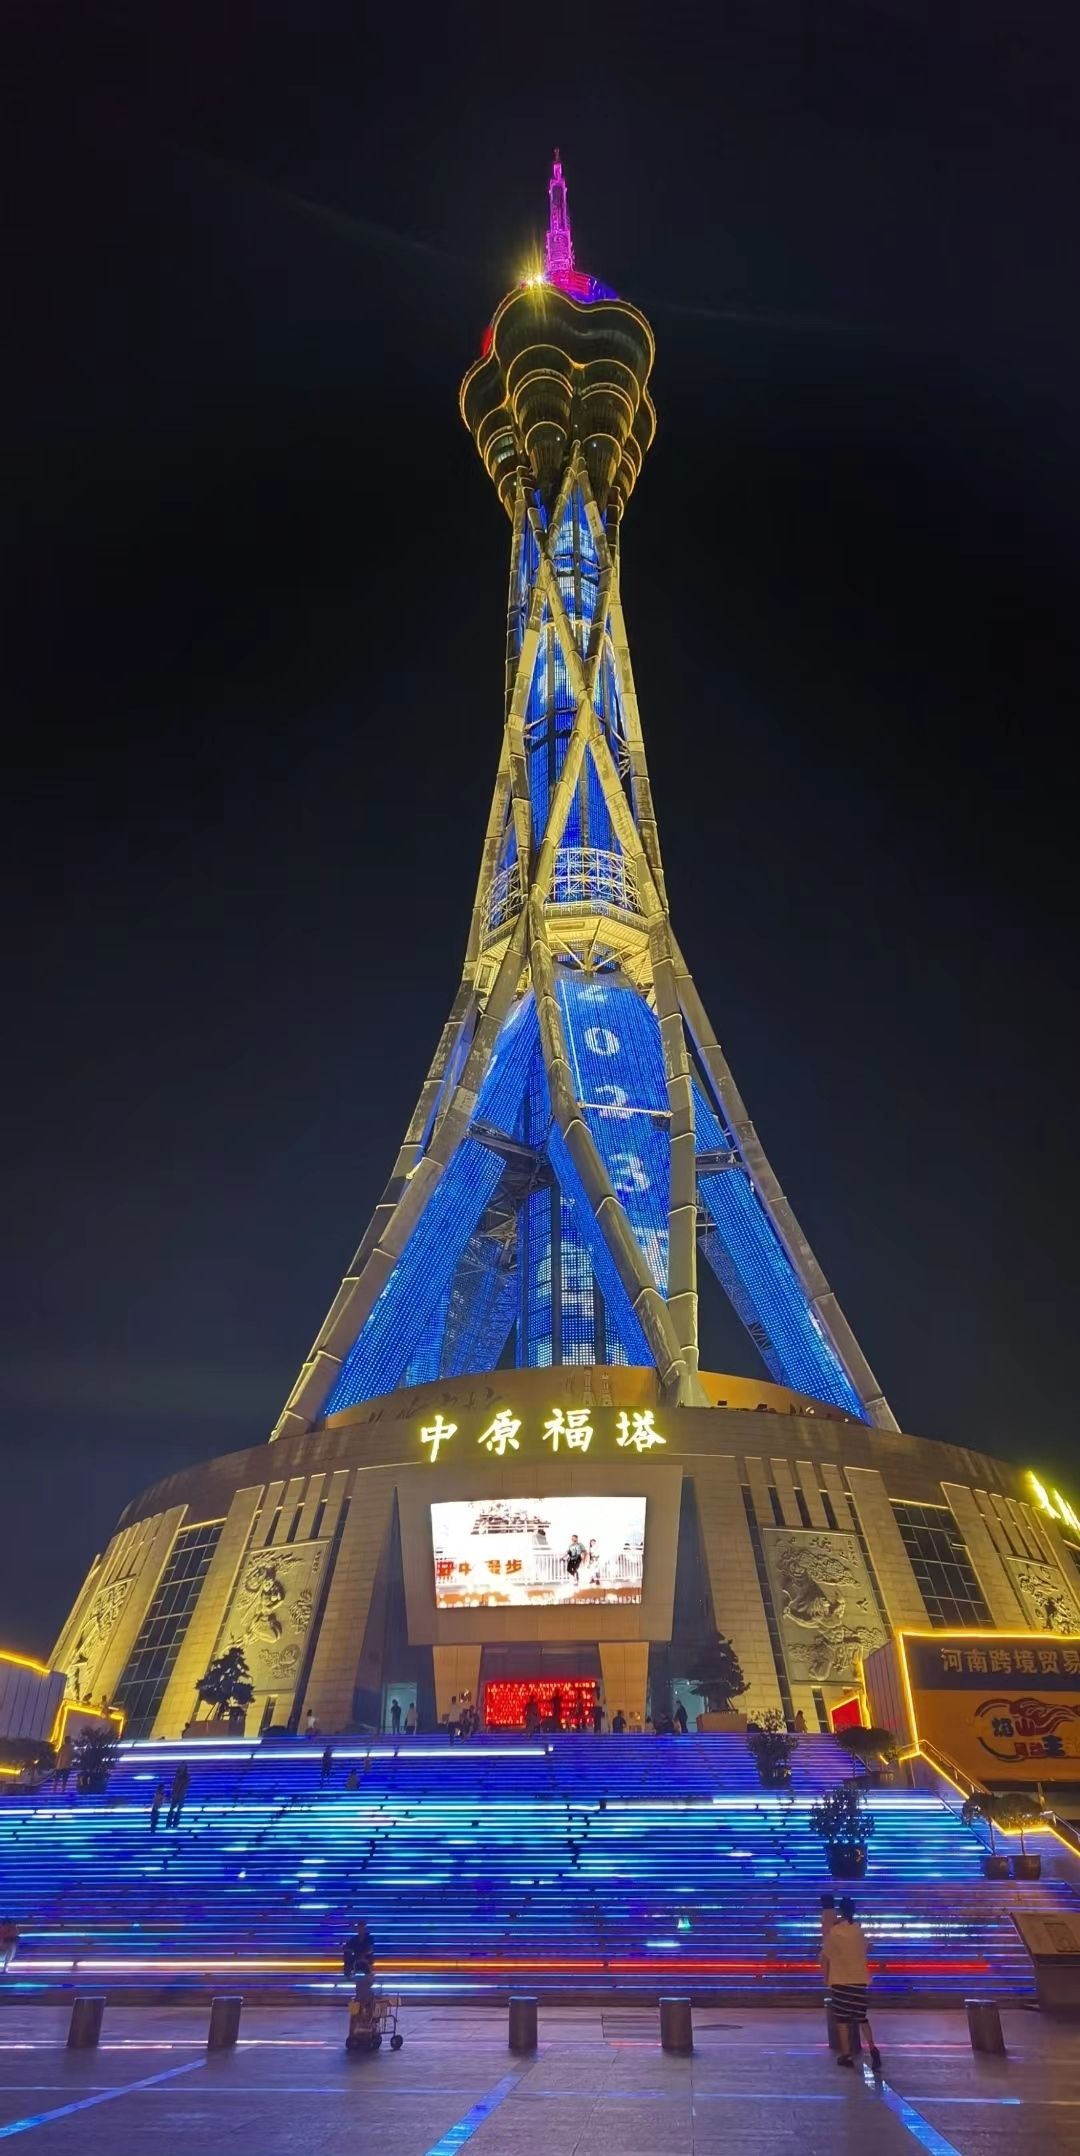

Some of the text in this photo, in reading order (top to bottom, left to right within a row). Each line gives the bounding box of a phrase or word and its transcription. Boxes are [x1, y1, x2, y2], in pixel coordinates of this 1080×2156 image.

[419, 1407, 667, 1463] 中原福塔
[940, 1647, 1080, 1674] 河南跨境贸易
